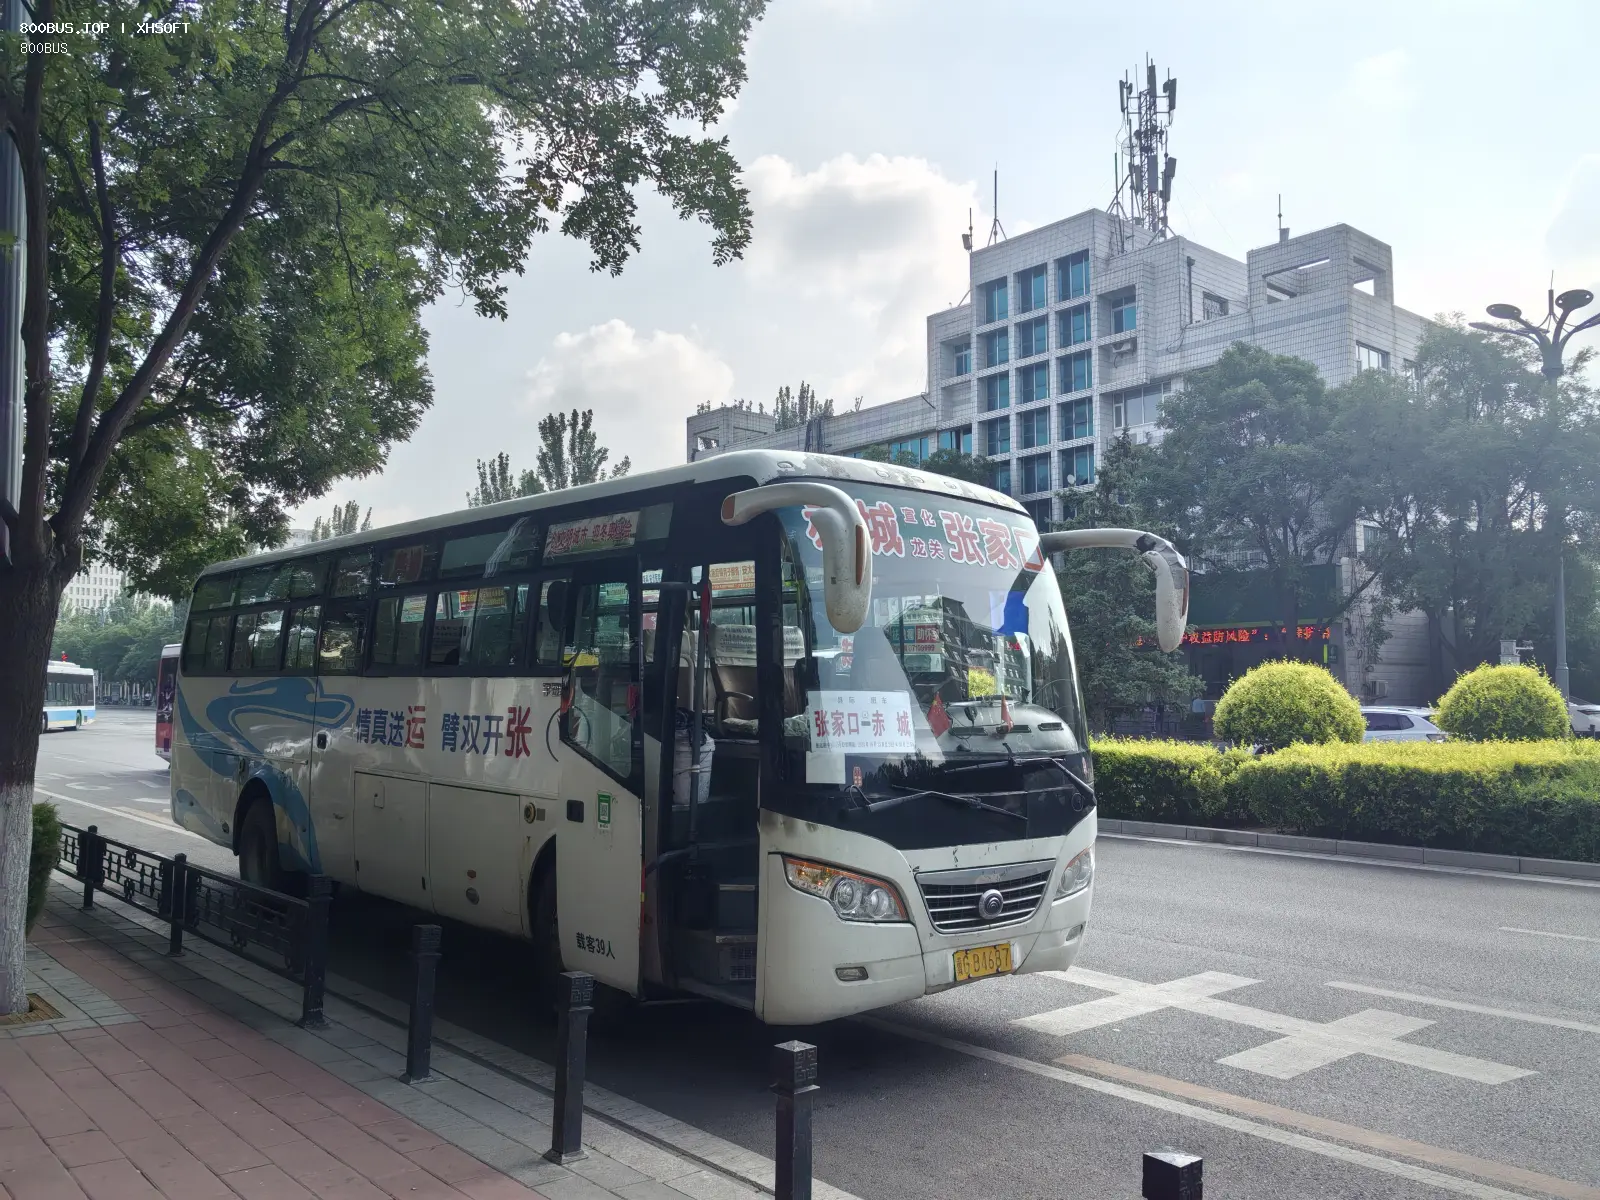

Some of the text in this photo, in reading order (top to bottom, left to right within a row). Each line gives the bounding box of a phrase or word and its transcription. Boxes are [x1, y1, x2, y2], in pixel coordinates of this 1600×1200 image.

[901, 507, 936, 527] 宣化
[909, 537, 945, 559] 龙关
[939, 510, 1046, 573] 张家口
[576, 932, 616, 960] 载客39人
